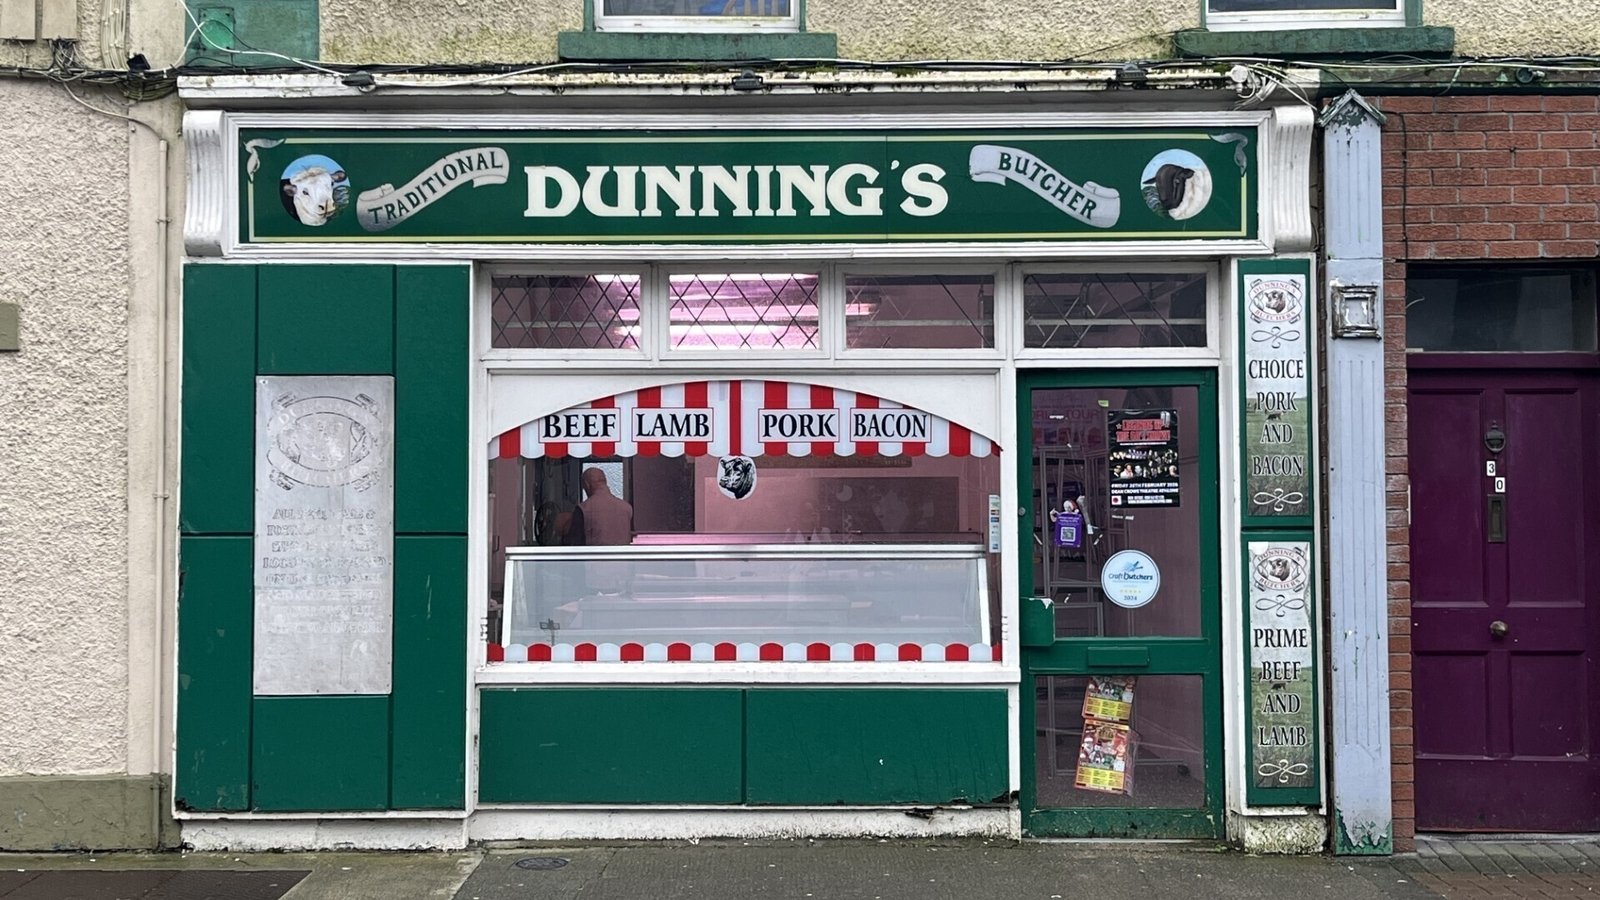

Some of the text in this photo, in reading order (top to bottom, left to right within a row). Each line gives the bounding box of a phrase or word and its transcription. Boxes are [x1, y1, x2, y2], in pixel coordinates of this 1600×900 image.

[367, 150, 504, 225] TRADITIONAL
[523, 159, 949, 217] DUNNING'S
[998, 152, 1098, 221] BUTCHER
[1254, 309, 1296, 321] BUTCHERS
[1248, 359, 1304, 379] CHOICE
[1256, 391, 1298, 411] PORK
[542, 413, 928, 438] BEEF LAMB PORK BACON
[1261, 424, 1293, 443] AND
[1252, 456, 1303, 476] BACON
[1488, 463, 1495, 474] 3
[1496, 479, 1504, 490] 0
[1259, 576, 1301, 589] BUTCHERS
[1253, 628, 1308, 648] PRIME
[1262, 661, 1301, 680] BEEF
[1263, 694, 1301, 713] AND
[1259, 726, 1306, 746] LAMB
